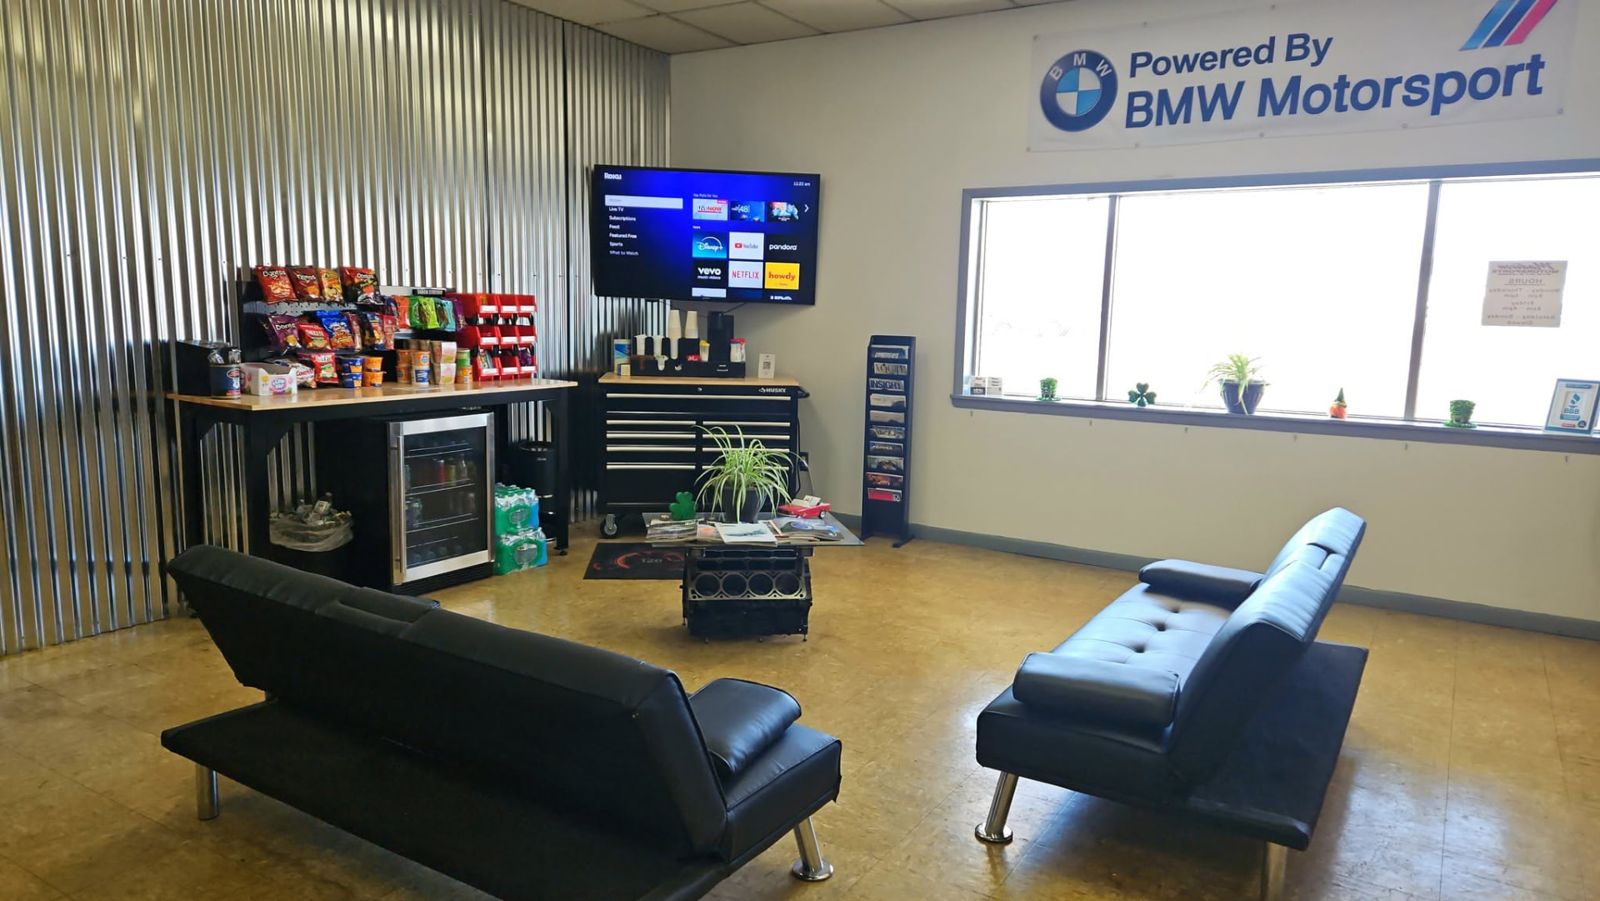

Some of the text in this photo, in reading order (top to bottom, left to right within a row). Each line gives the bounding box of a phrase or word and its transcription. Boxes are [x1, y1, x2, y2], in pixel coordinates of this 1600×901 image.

[1129, 33, 1334, 78] Powered By
[1049, 52, 1112, 80] BMW
[1125, 54, 1545, 128] BMW Motorsport
[698, 267, 721, 275] vevo
[732, 271, 759, 279] NETFLIX
[768, 272, 796, 281] howdy
